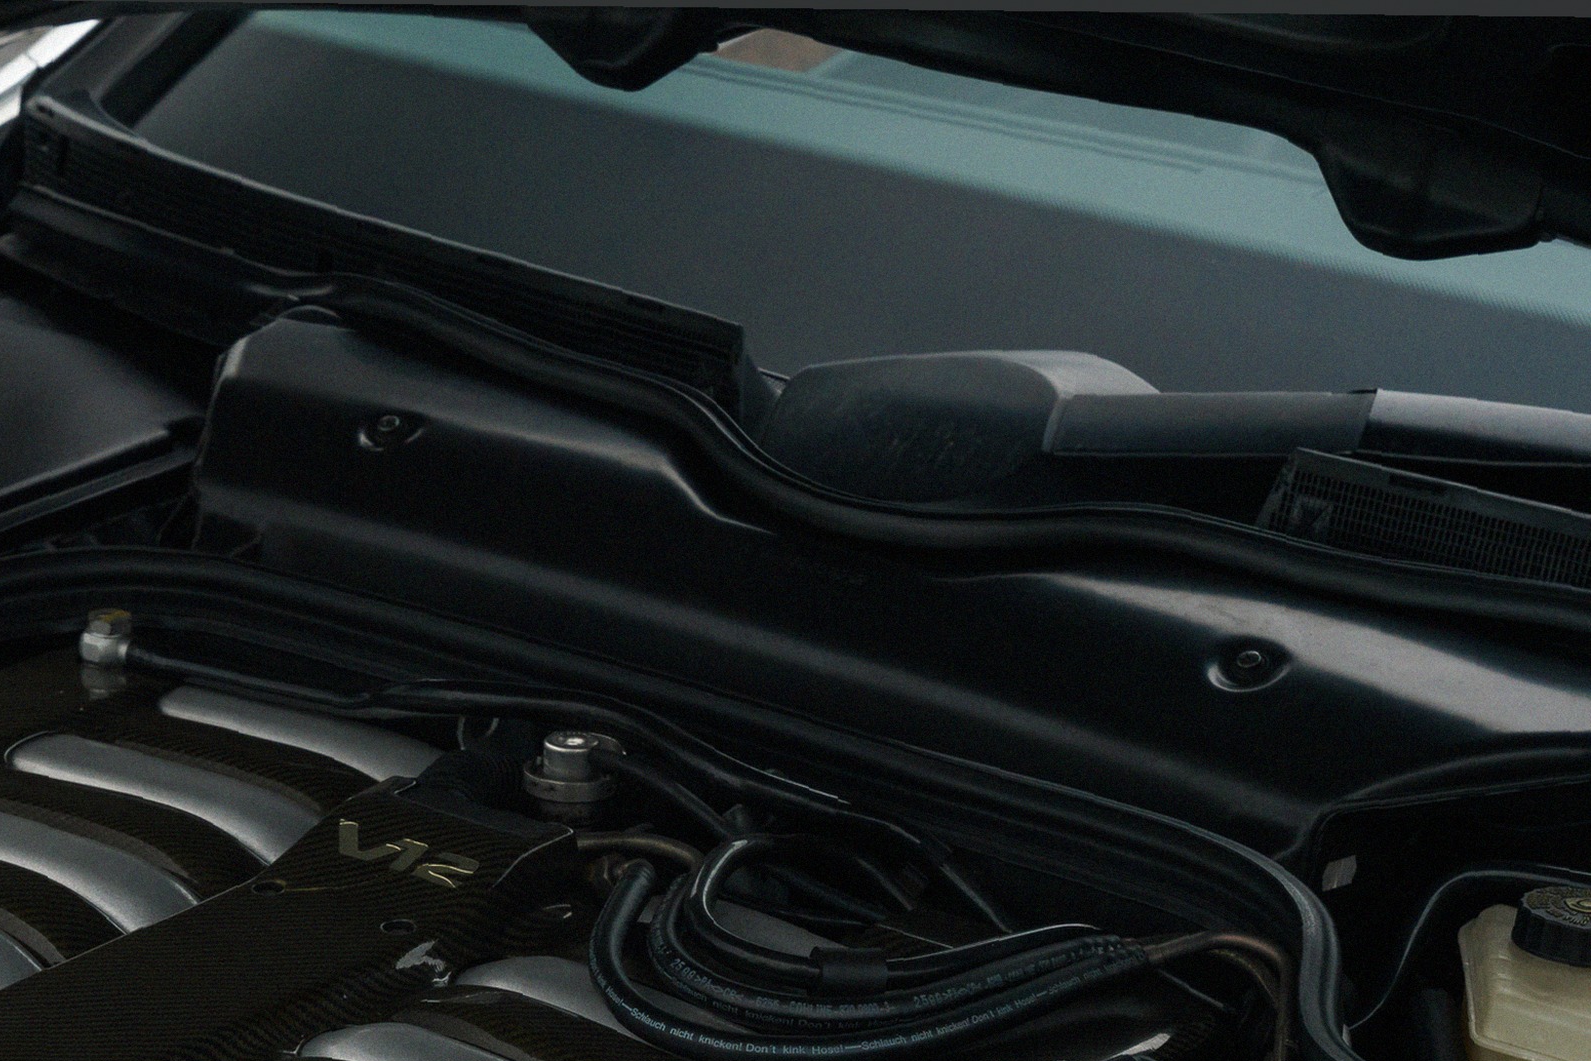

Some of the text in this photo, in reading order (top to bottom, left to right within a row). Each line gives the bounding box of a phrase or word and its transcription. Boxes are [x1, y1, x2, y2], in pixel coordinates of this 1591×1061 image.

[339, 819, 479, 888] V12
[670, 1026, 695, 1041] nicht
[698, 1033, 743, 1051] knicken!
[783, 1045, 806, 1054] kink
[911, 1029, 933, 1043] nicht
